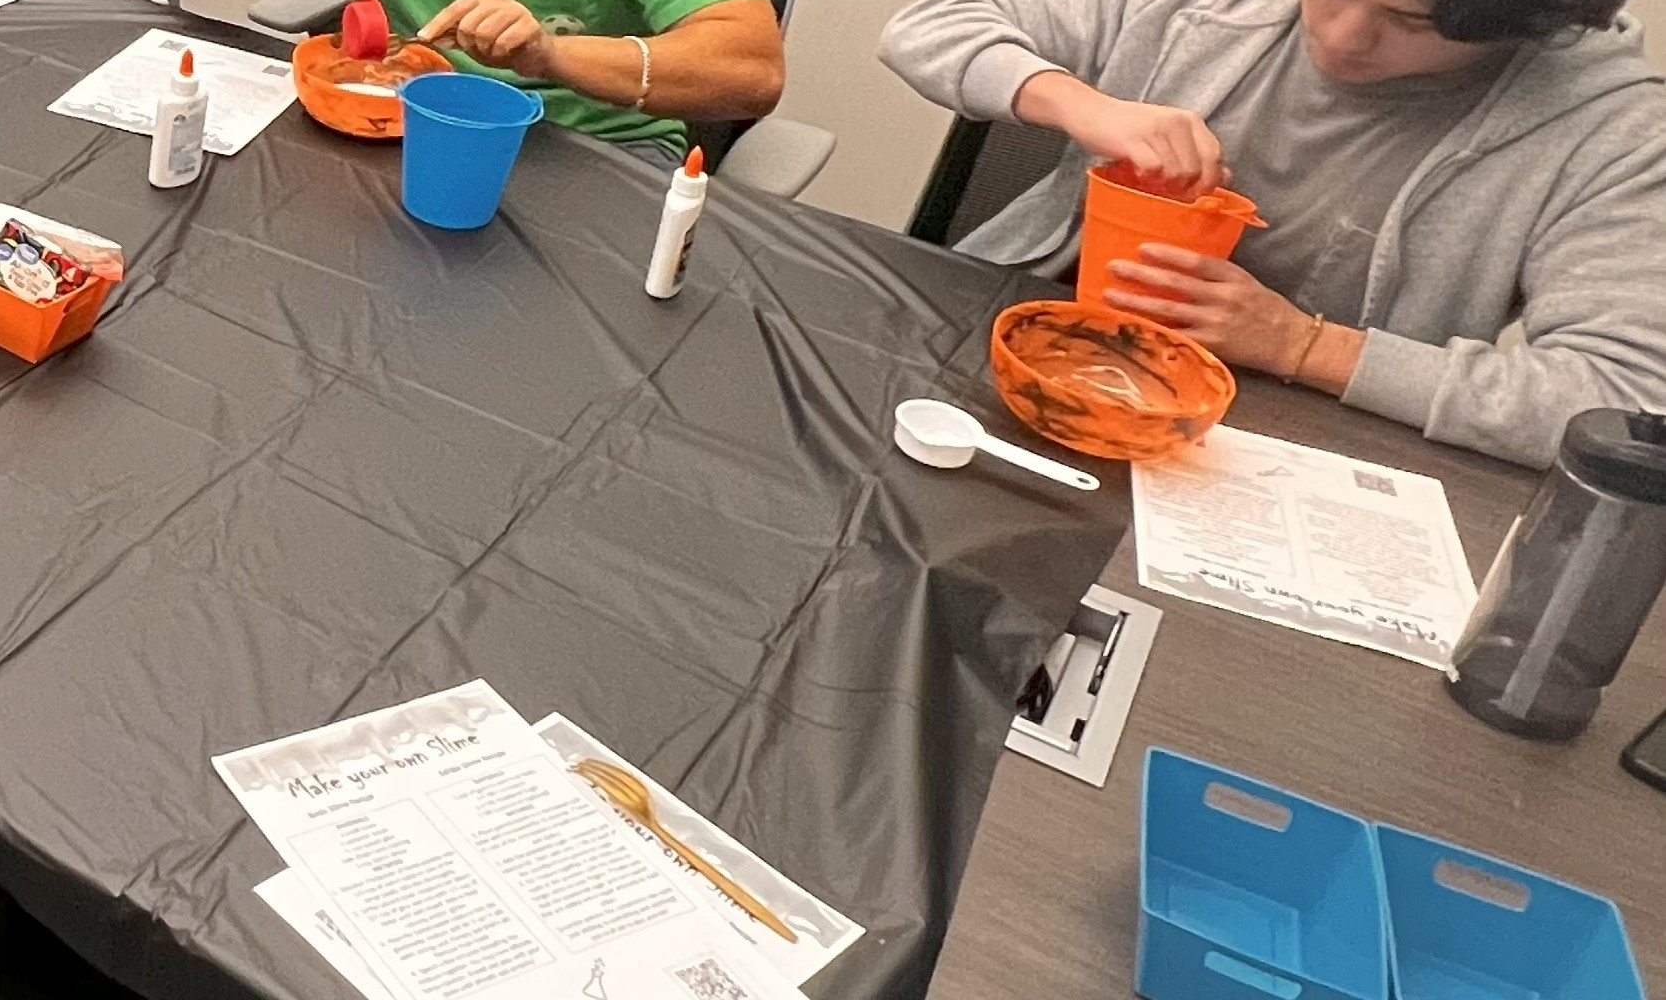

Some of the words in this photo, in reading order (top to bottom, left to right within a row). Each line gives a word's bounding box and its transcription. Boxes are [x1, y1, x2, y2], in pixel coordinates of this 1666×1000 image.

[287, 773, 343, 799] Make
[347, 763, 389, 791] your
[395, 753, 430, 770] own
[426, 733, 481, 758] Slime
